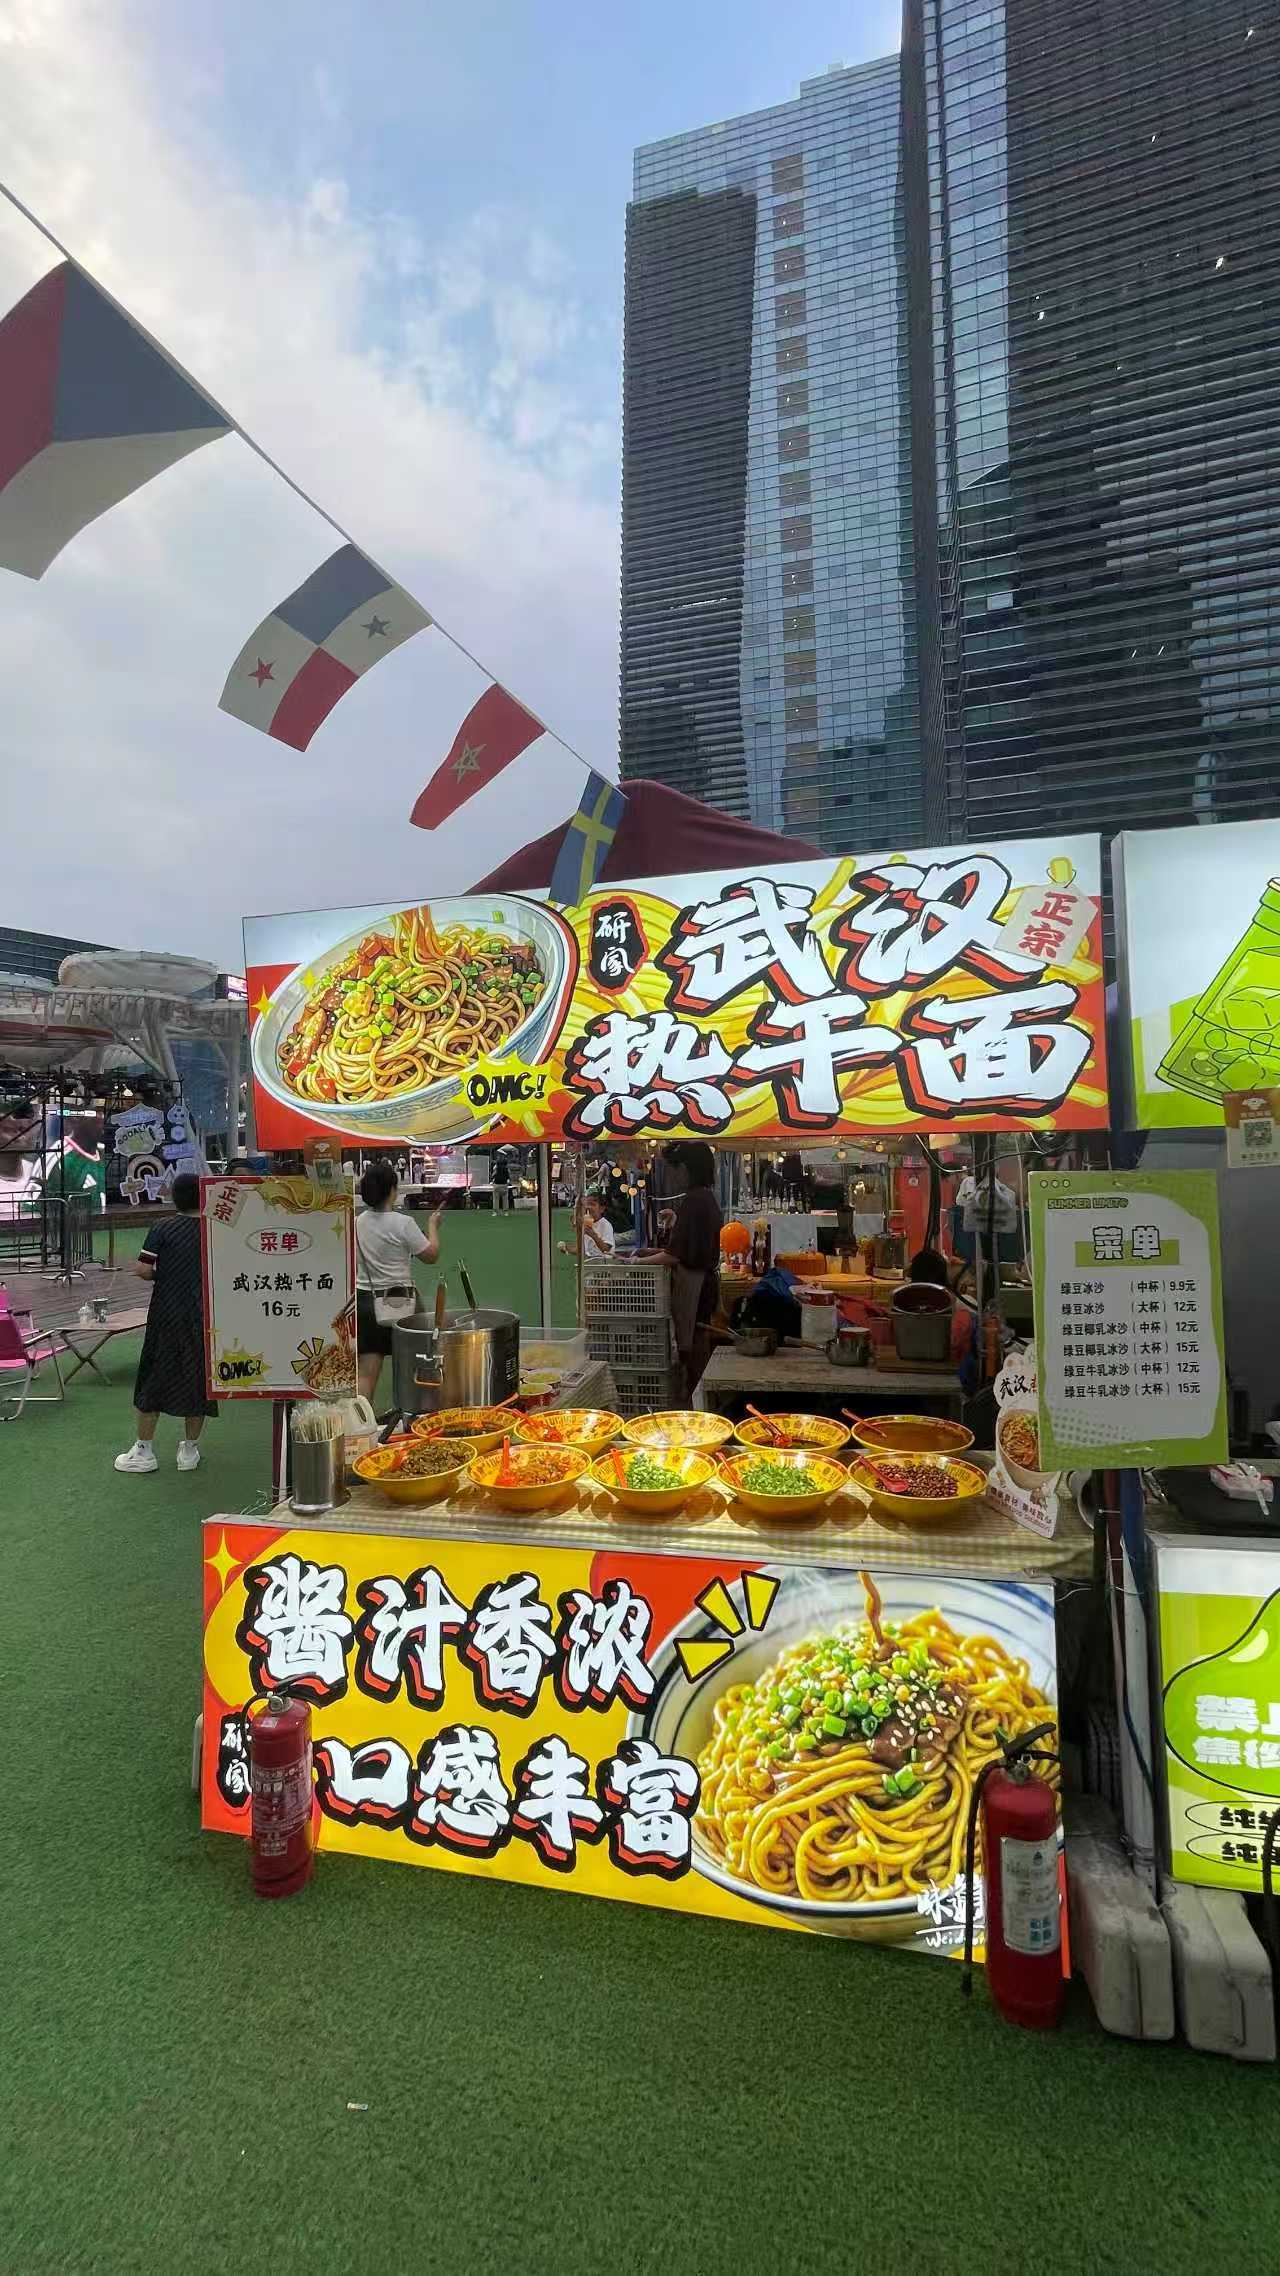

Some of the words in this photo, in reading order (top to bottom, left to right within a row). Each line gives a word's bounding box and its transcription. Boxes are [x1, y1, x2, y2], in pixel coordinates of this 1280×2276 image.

[668, 854, 1050, 1010] 武汉
[1017, 890, 1080, 959] 正宗
[570, 982, 1092, 1133] 热干面
[213, 1185, 240, 1222] 正宗
[1048, 1198, 1091, 1210] SUMMER
[260, 1231, 300, 1252] 菜单
[1093, 1225, 1161, 1260] 菜单
[232, 1272, 335, 1292] 武汉热干面
[1061, 1282, 1105, 1296] 绿豆冰沙
[261, 1300, 301, 1318] 16元
[1061, 1302, 1105, 1316] 绿豆冰沙
[246, 1555, 659, 1710] 酱汁香浓
[318, 1726, 699, 1868] 口感丰富
